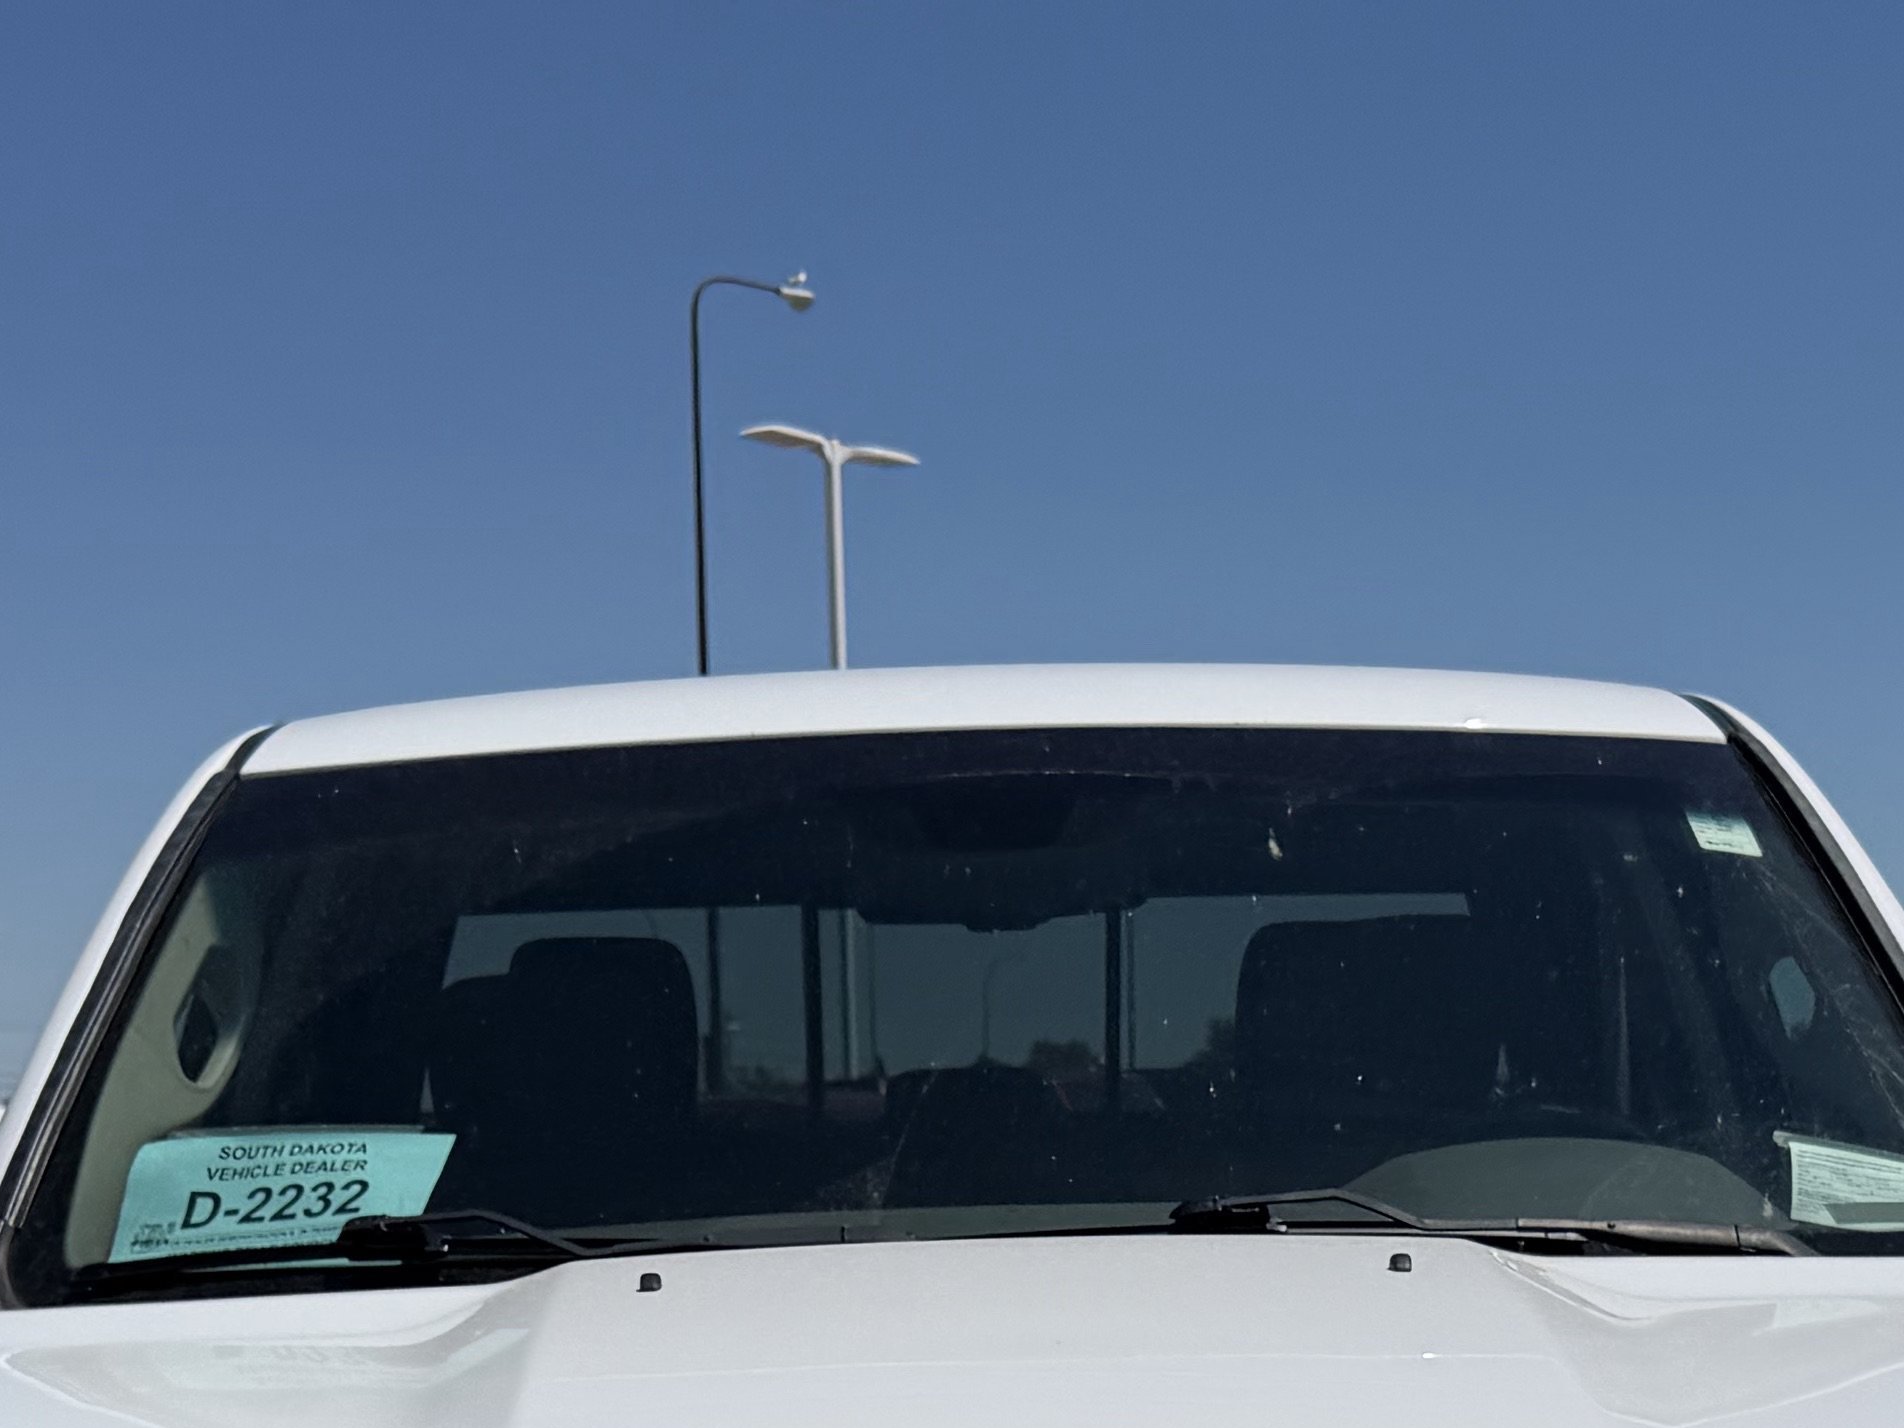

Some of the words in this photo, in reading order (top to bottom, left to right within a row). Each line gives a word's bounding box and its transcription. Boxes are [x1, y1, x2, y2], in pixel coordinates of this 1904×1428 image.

[218, 1144, 286, 1161] SOUTH
[290, 1142, 368, 1158] DAKOTA
[206, 1163, 285, 1181] VEHICLE
[290, 1158, 368, 1175] DEALER
[180, 1180, 369, 1229] D-2232
